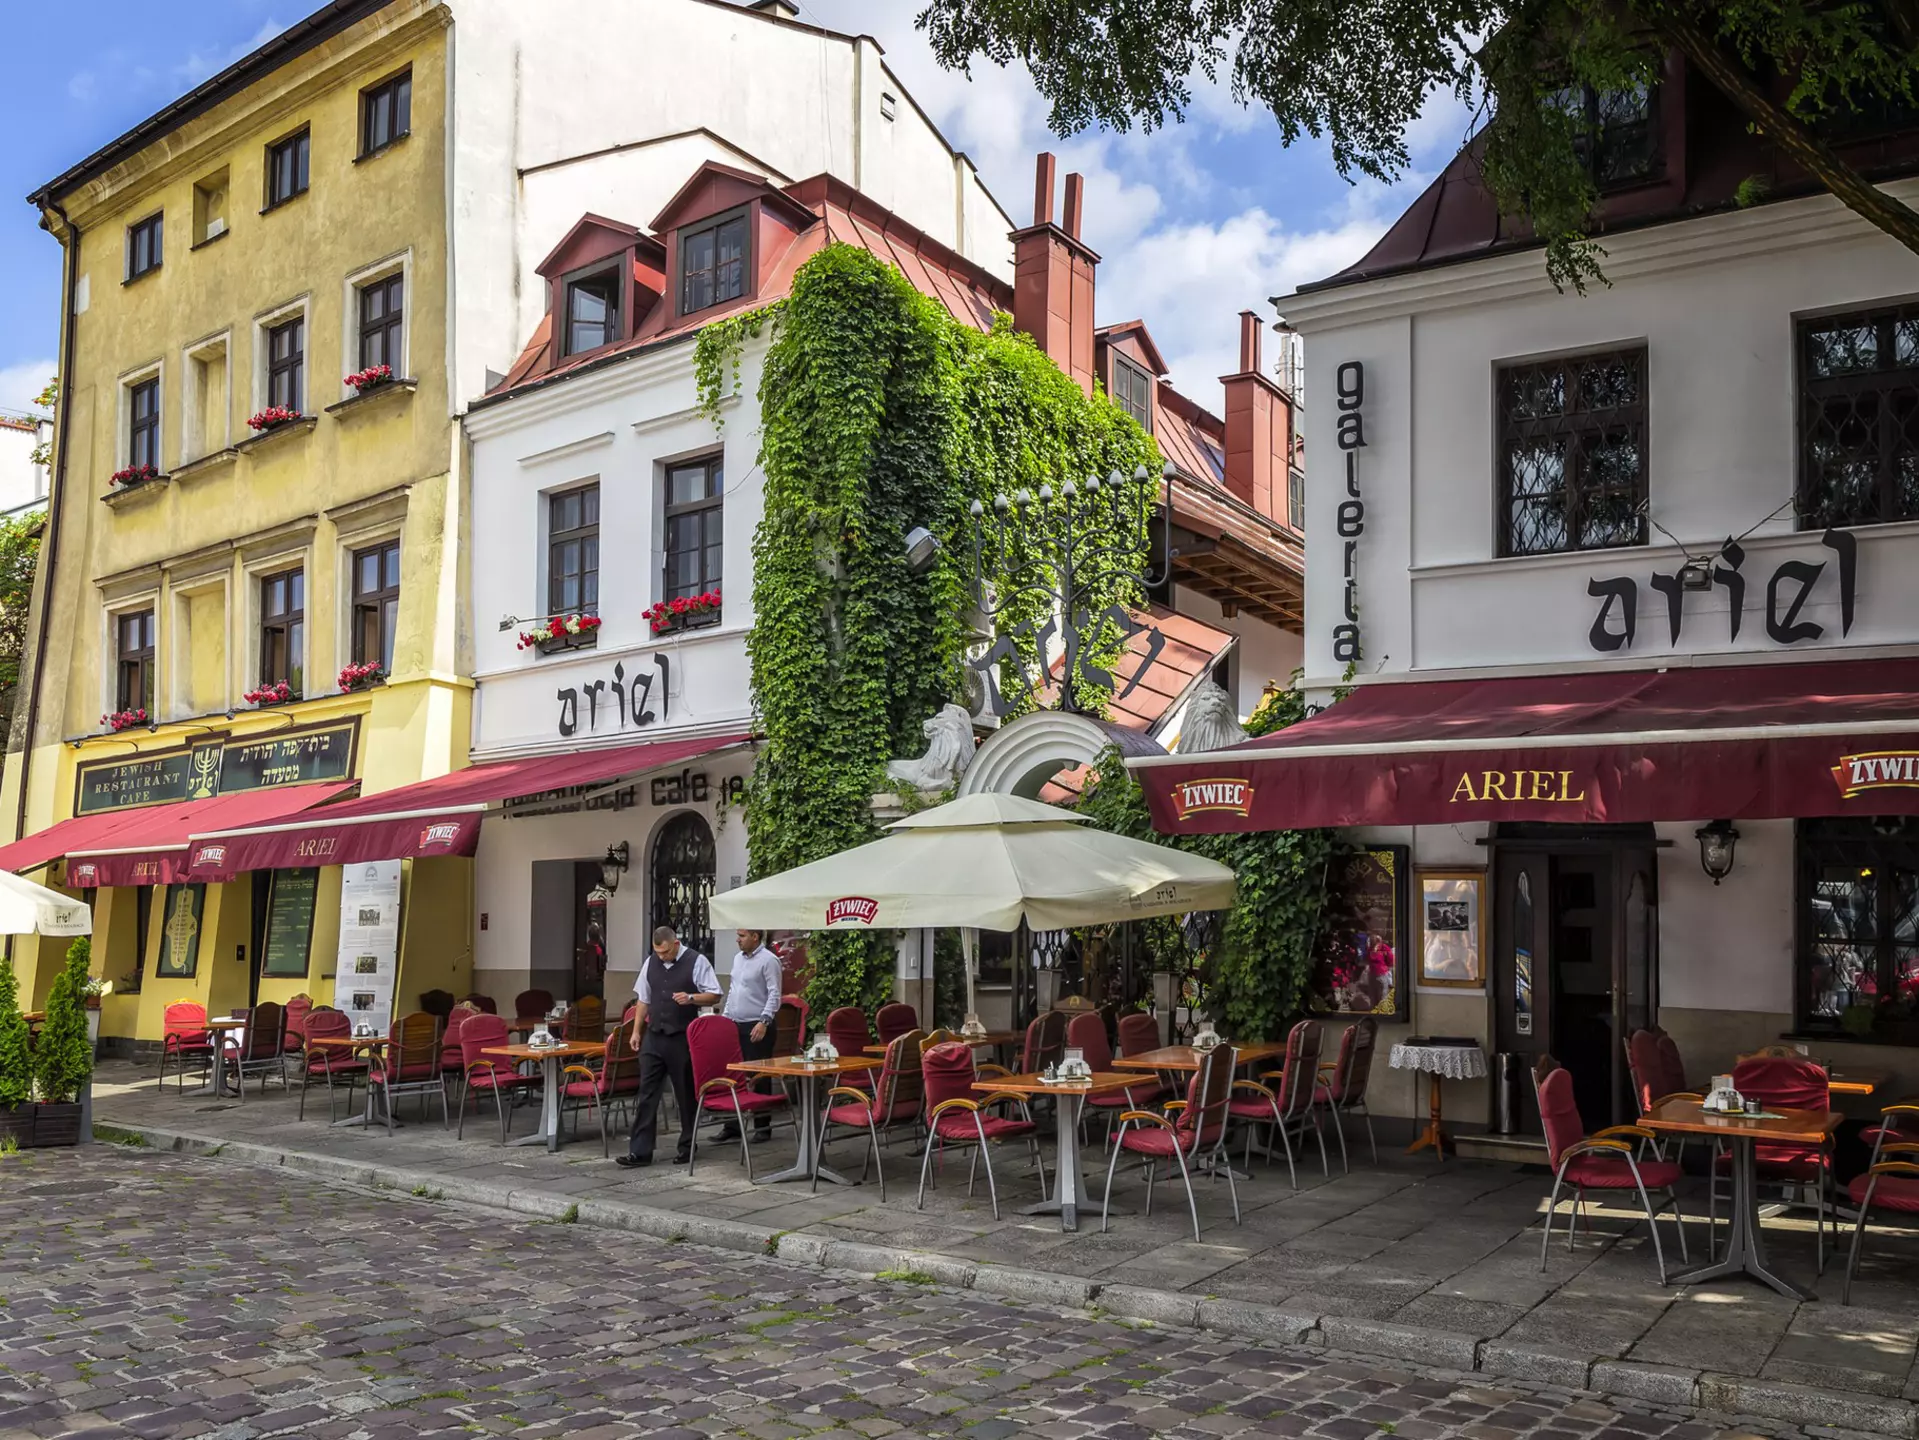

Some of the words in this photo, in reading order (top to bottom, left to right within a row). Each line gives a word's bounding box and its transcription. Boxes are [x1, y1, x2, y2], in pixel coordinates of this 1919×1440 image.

[1332, 360, 1368, 664] galeria
[1586, 527, 1858, 652] ariel
[557, 651, 670, 737] ariel
[95, 772, 181, 794] RESTAURANT
[112, 761, 163, 779] JEWISH
[1848, 757, 1919, 785] ŻYWI
[120, 791, 150, 805] CAFE
[651, 768, 708, 806] cafe
[1182, 783, 1245, 808] ŻYWIEC
[1449, 770, 1585, 803] ARIEL
[293, 838, 337, 857] ARIEL
[833, 899, 874, 917] ŻYWIEC
